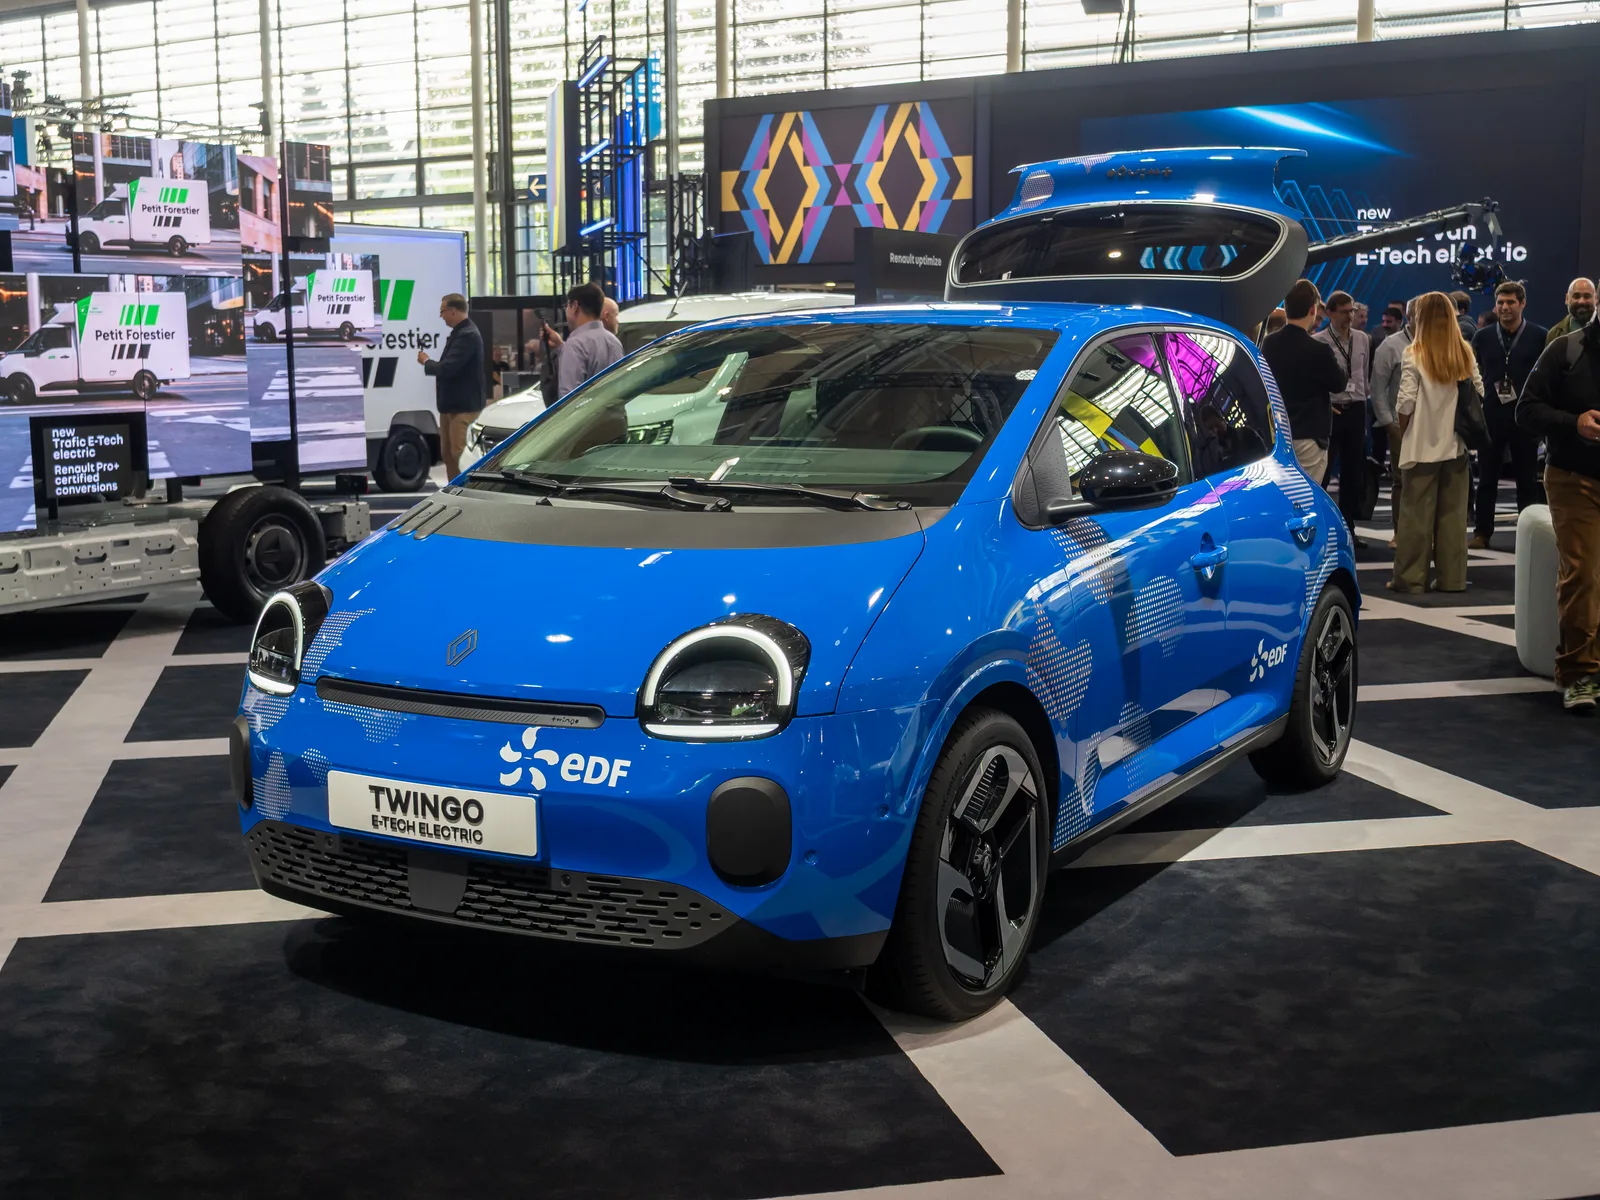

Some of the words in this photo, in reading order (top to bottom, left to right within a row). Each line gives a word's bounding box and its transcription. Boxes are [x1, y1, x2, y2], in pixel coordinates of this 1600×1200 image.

[141, 204, 161, 213] Petit
[163, 205, 200, 215] Forestier
[1357, 207, 1392, 220] new
[889, 252, 914, 265] Renault
[1356, 244, 1431, 266] E-Tech
[317, 294, 335, 302] Petit
[335, 294, 366, 302] Forestier
[95, 328, 123, 341] Petit
[126, 328, 176, 341] Forestier
[52, 427, 76, 438] new
[52, 436, 86, 449] Trafic
[87, 433, 124, 447] E-Tech
[53, 446, 96, 460] electric
[54, 462, 95, 476] Renault
[96, 461, 120, 472] Pro+
[55, 472, 100, 486] certified
[55, 482, 118, 496] conversions
[368, 784, 484, 825] TWINGO
[371, 814, 416, 836] E-TECH
[418, 821, 484, 845] ELECTRIC
